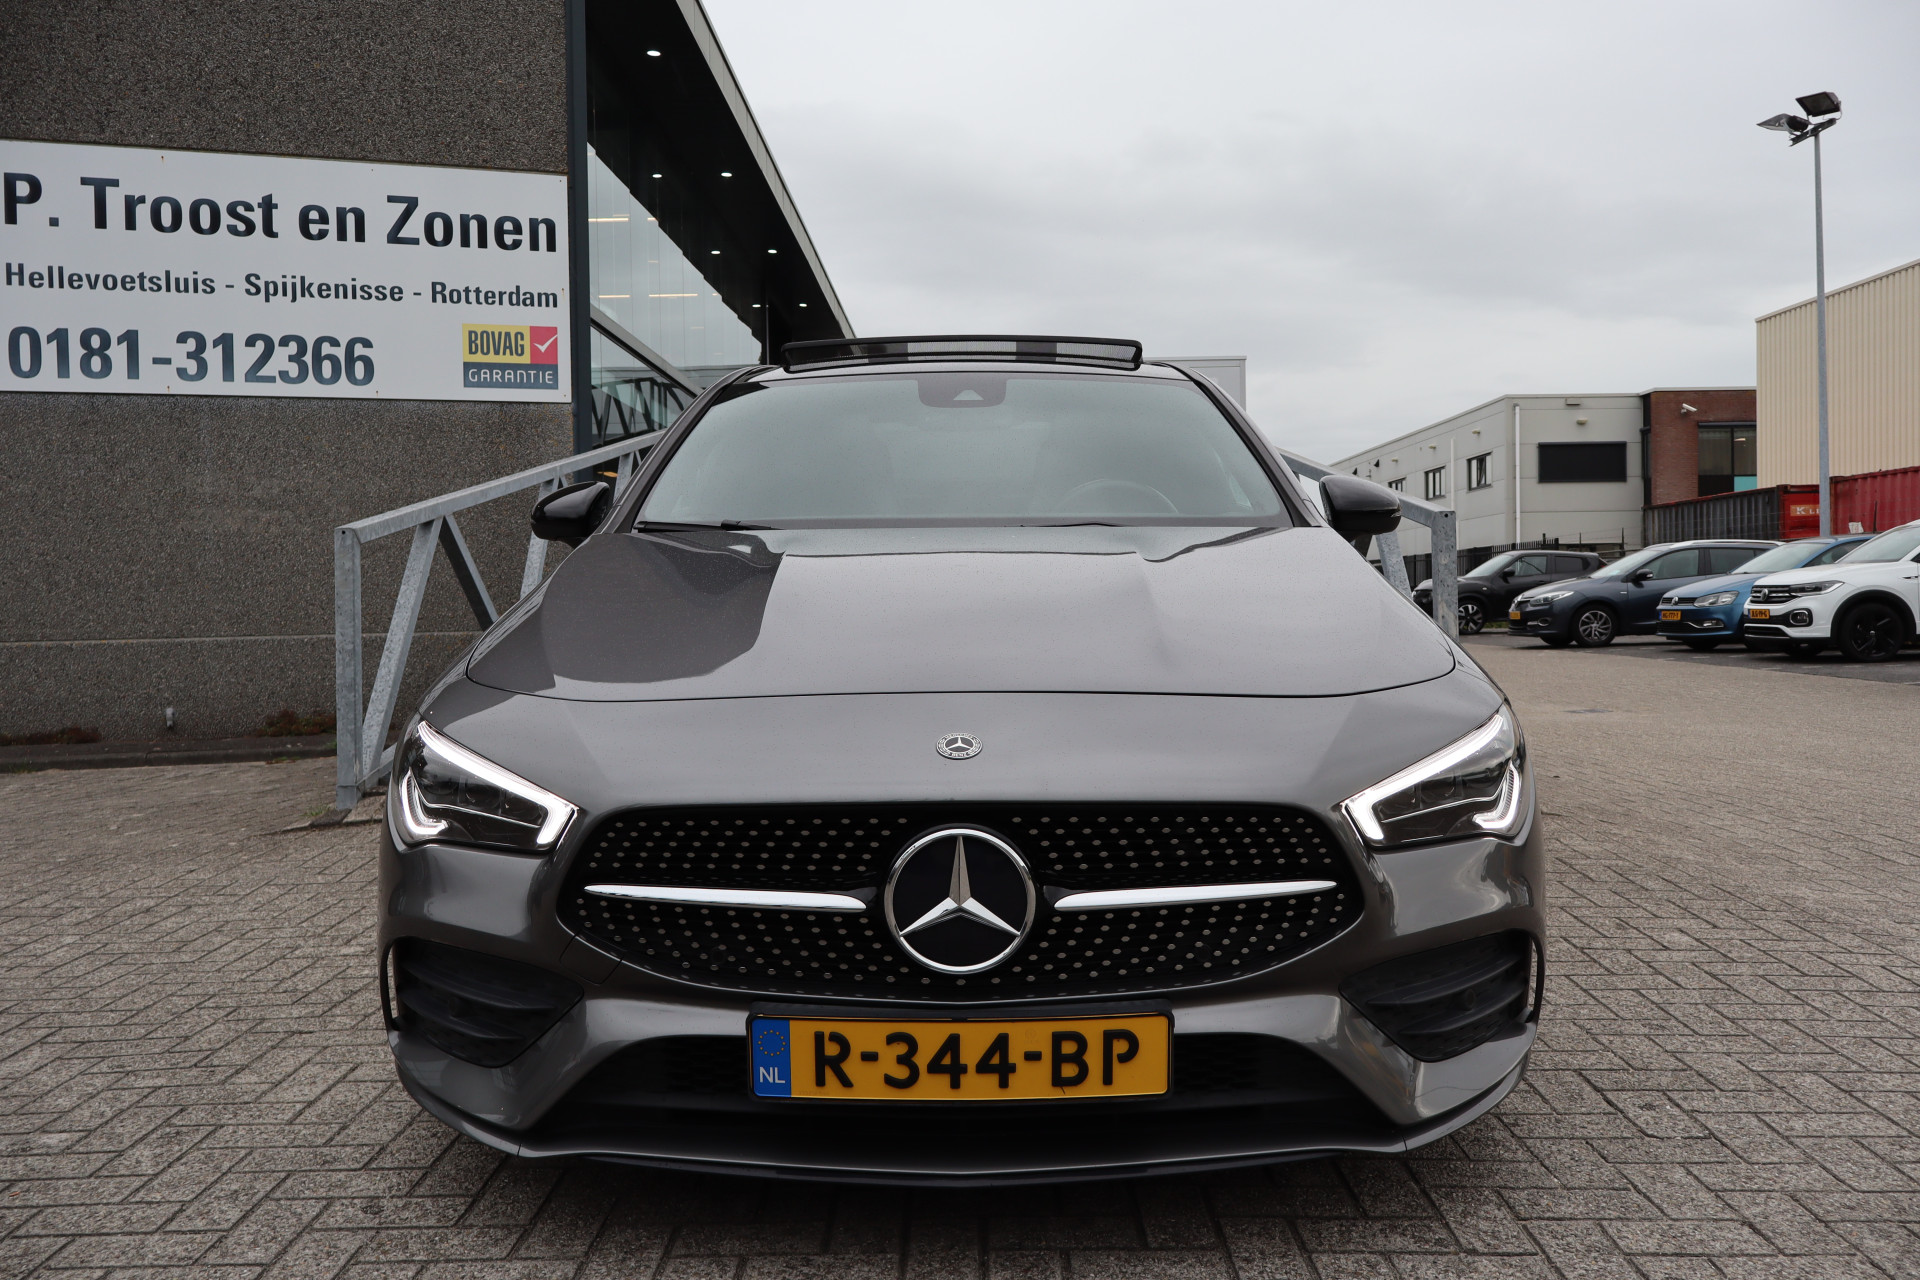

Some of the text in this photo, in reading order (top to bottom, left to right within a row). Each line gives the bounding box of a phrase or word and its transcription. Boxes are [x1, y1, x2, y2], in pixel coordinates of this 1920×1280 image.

[3, 172, 557, 253] P. Troost en Zonen
[5, 262, 216, 295] Hellevoetsluis
[244, 273, 404, 304] Spijkenisse
[430, 281, 558, 309] Rotterdam
[8, 325, 375, 386] 0181-312366
[468, 330, 525, 358] BOVAG
[468, 368, 554, 385] GARANTIE
[758, 1066, 786, 1084] NL
[814, 1029, 1140, 1090] R-344-BP
